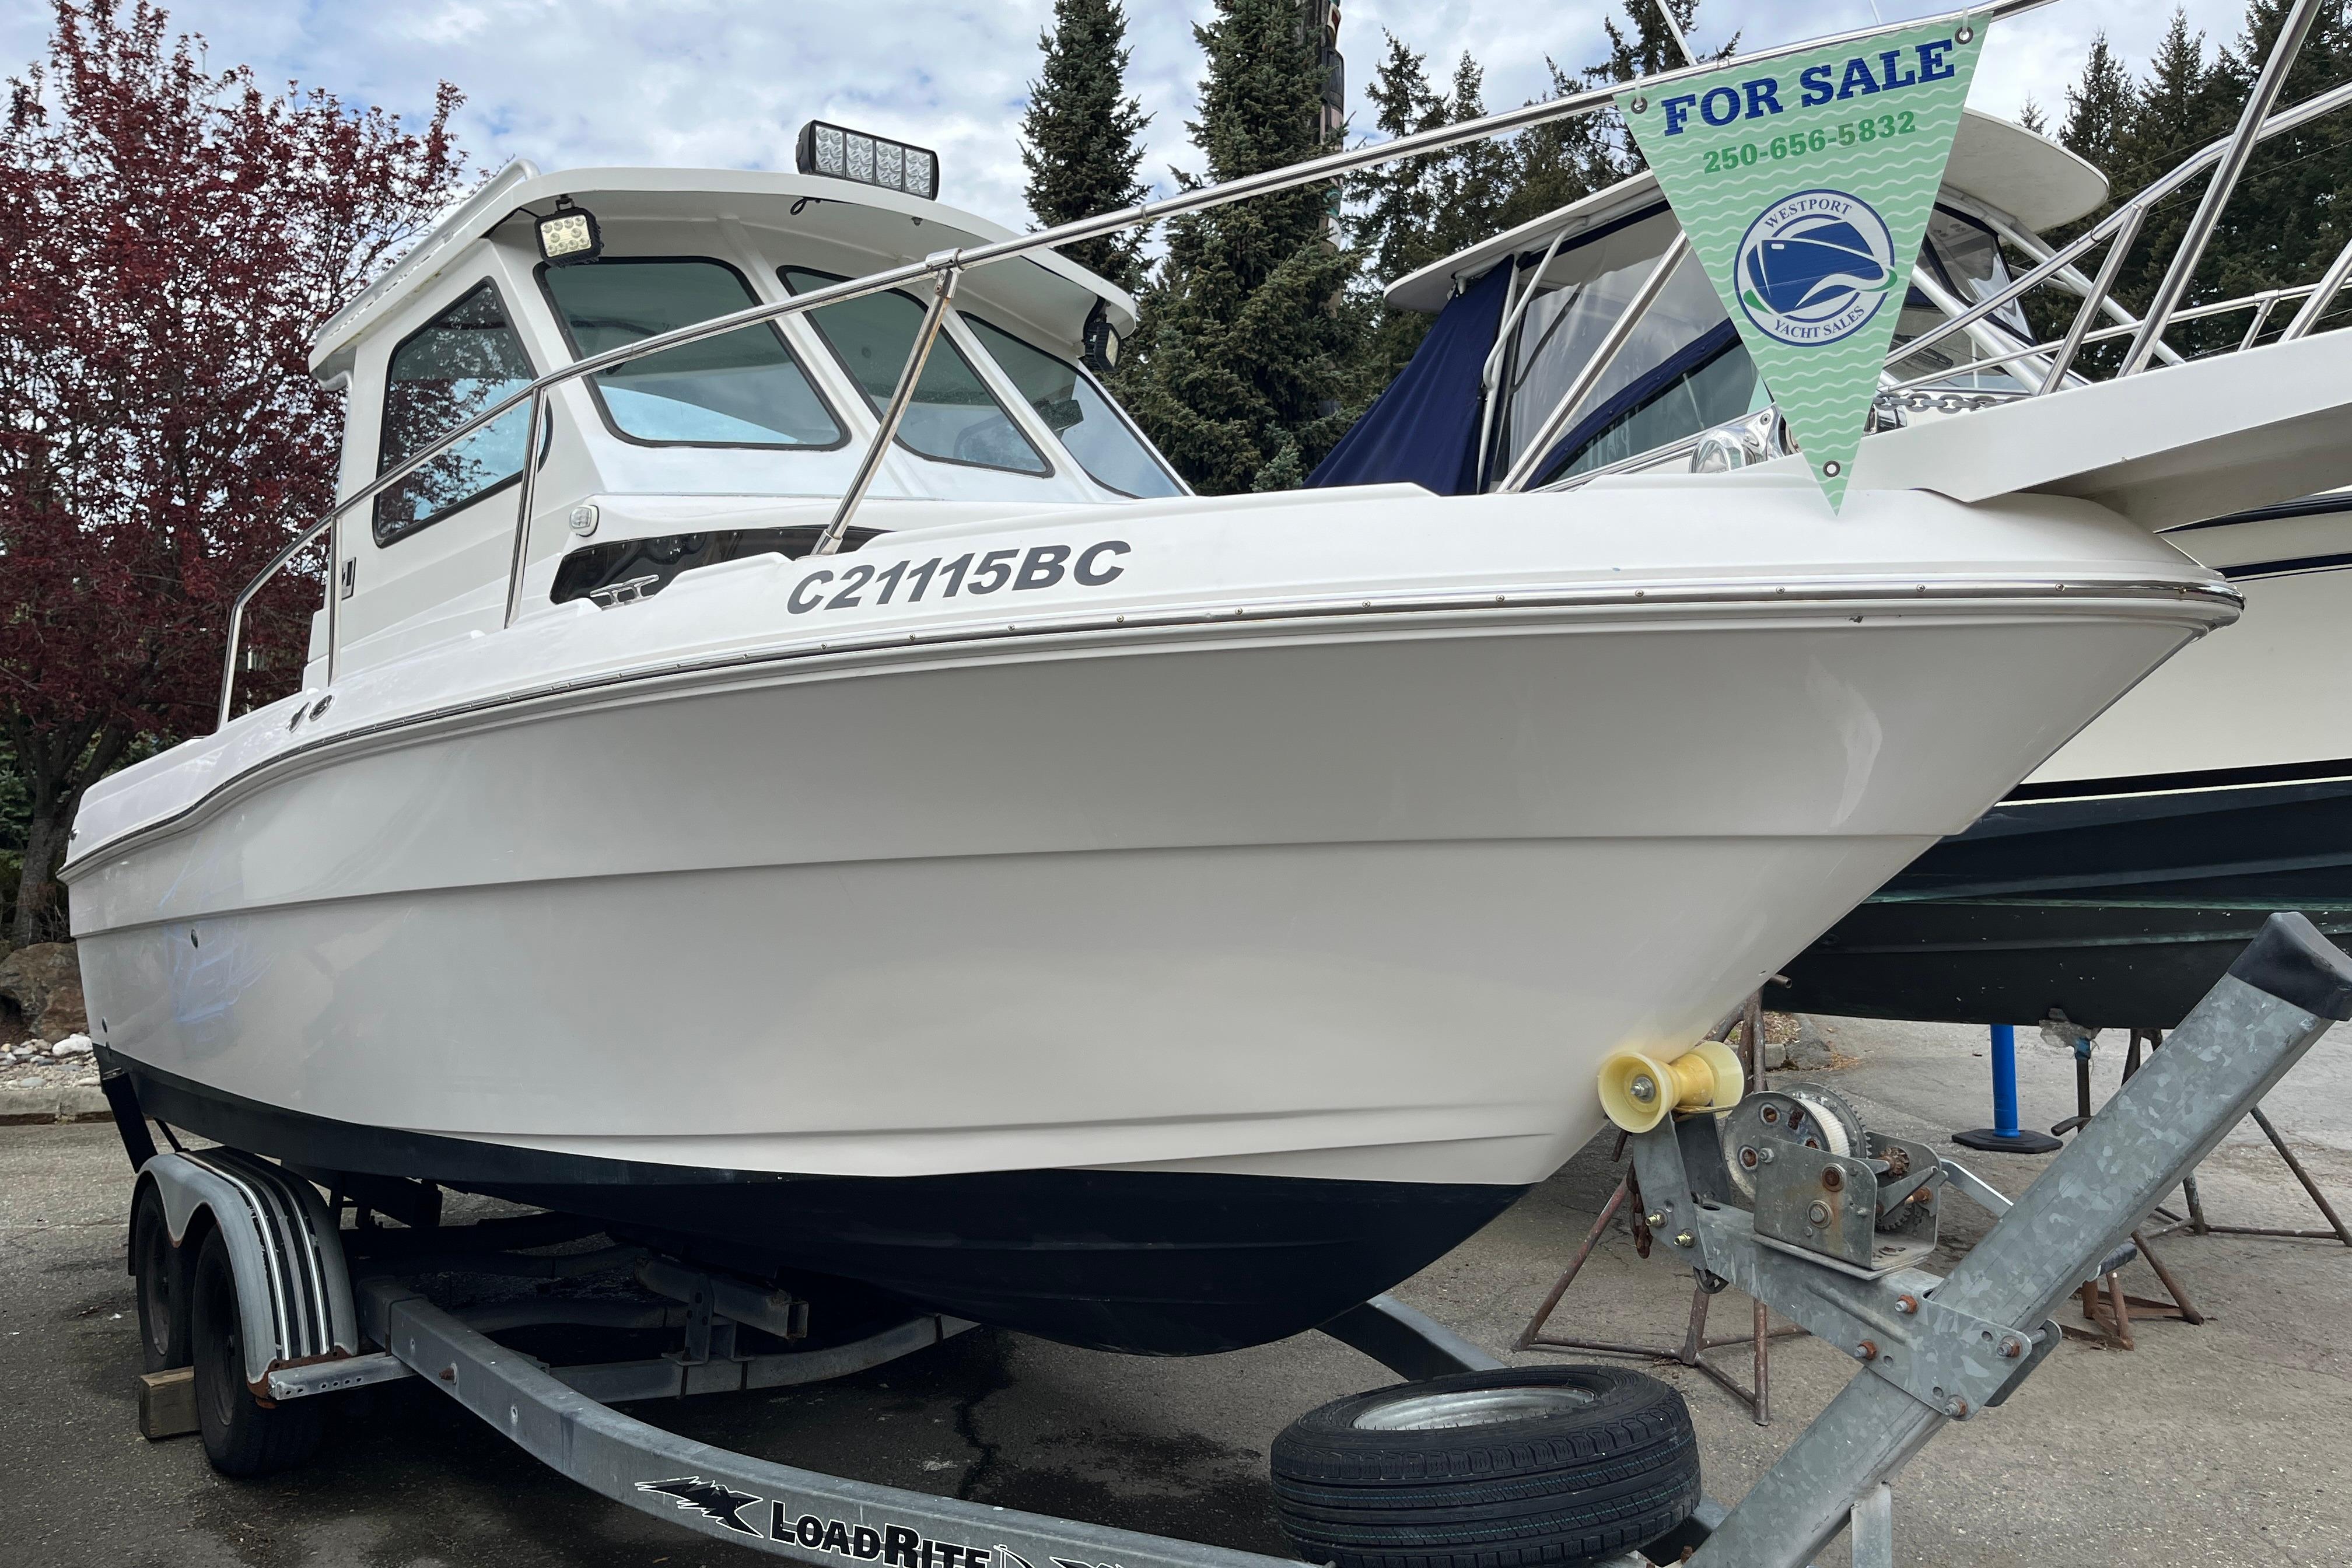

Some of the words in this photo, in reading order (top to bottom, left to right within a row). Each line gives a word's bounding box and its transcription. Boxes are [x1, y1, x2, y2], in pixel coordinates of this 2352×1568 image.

[1661, 78, 1783, 136] FOR
[1800, 39, 1955, 107] SALE
[1703, 111, 1916, 174] 250-656-5832
[1764, 199, 1852, 229] WESTPORT
[1774, 319, 1820, 338] YACHT
[1824, 306, 1864, 336] SALES
[788, 540, 1131, 614] C21115BC
